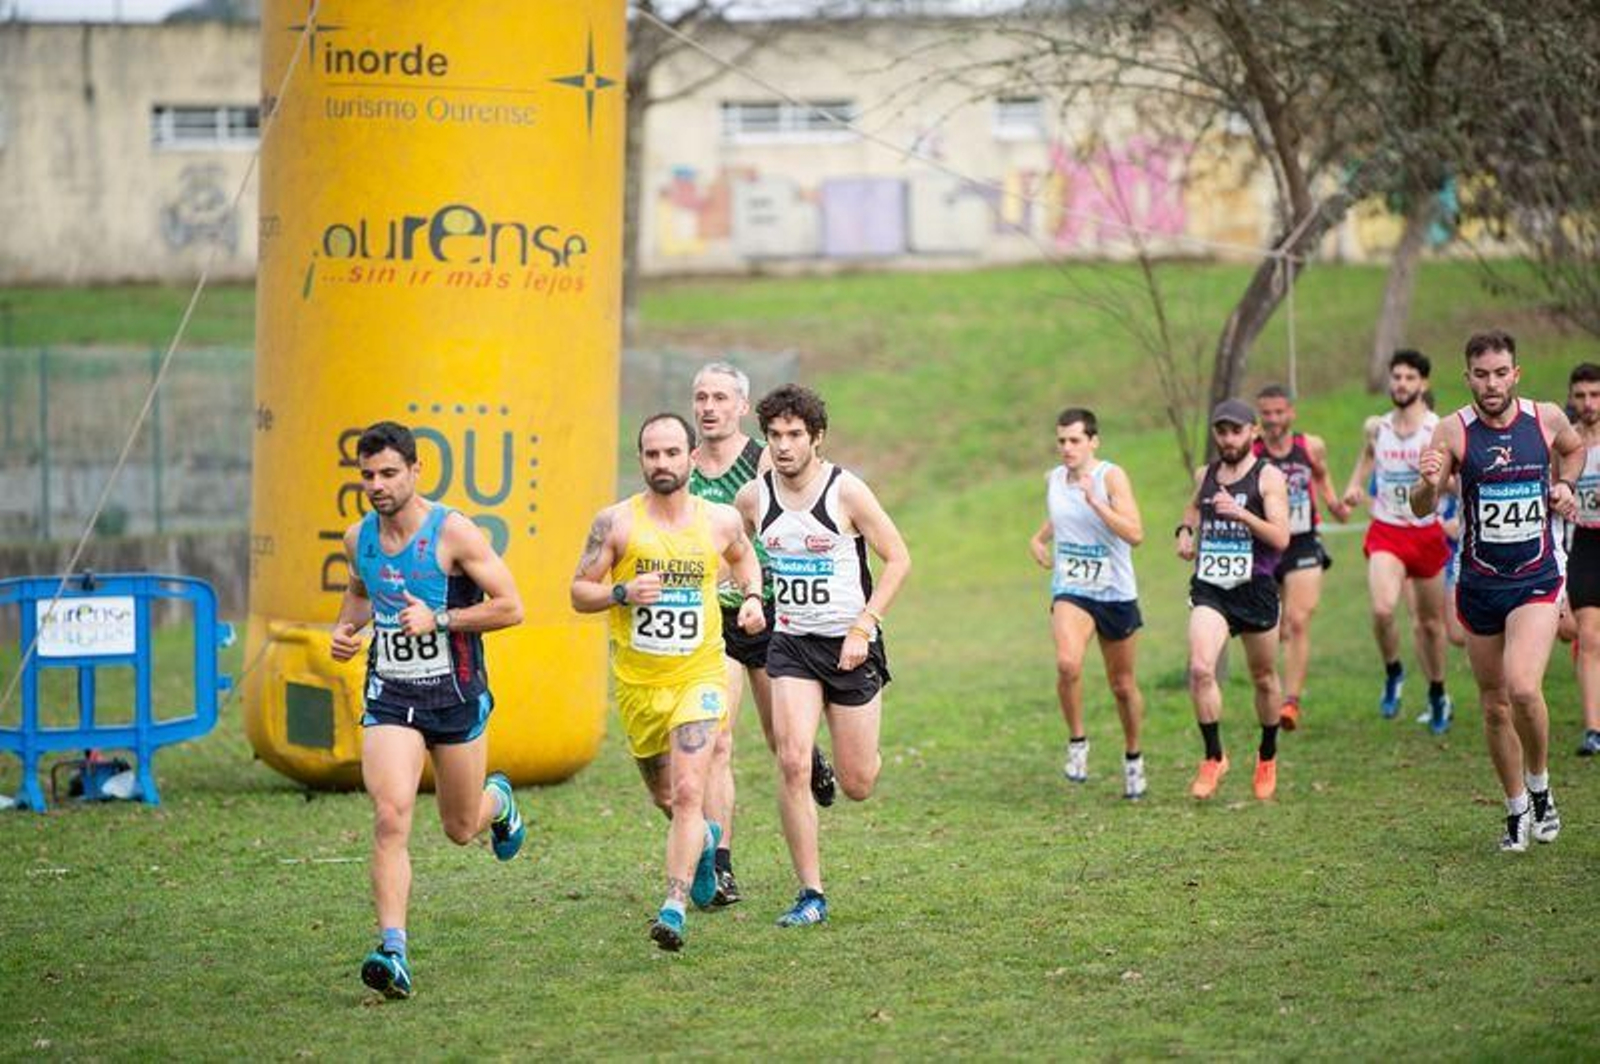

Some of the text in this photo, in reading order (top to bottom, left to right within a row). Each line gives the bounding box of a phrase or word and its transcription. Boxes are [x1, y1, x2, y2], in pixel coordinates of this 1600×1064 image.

[325, 42, 448, 76] inorde
[325, 95, 537, 125] turismo Ourense
[1483, 500, 1543, 528] 244
[1067, 557, 1103, 580] 217
[1203, 554, 1248, 577] 293
[776, 576, 831, 606] 206
[636, 607, 699, 640] 239
[382, 630, 439, 662] 188
